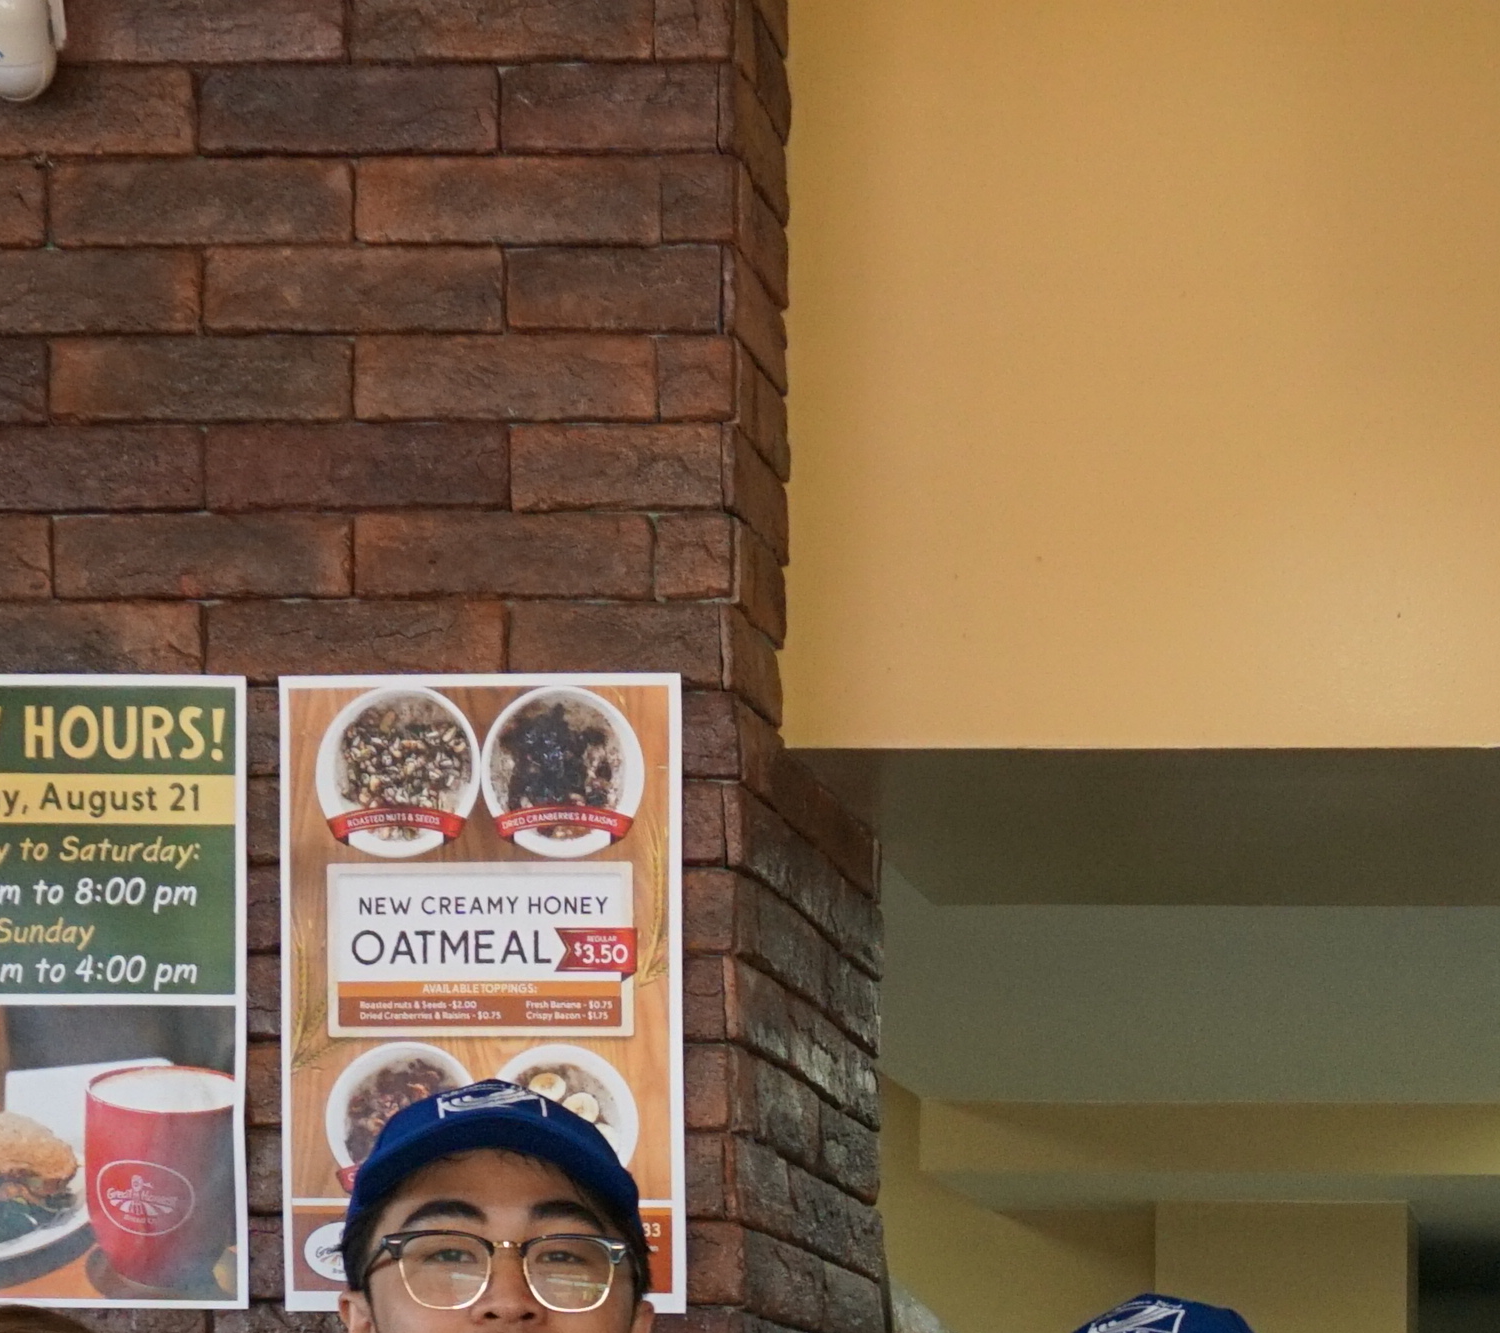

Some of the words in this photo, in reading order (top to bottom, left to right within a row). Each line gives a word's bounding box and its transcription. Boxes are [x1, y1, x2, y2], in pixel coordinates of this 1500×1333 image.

[24, 704, 226, 762] HOURS!
[39, 781, 158, 818] August
[168, 782, 201, 812] 21
[347, 813, 385, 827] ROASTED
[385, 811, 407, 824] NUTS
[415, 813, 441, 827] SEEDS
[524, 811, 581, 825] CRANBERRIES
[20, 837, 50, 862] to
[59, 835, 201, 870] Saturday:
[34, 877, 65, 906] to
[75, 875, 146, 906] 8:00
[151, 881, 198, 914] pm
[358, 896, 412, 916] NEW
[420, 895, 519, 916] CREAMY
[528, 895, 609, 916] HONEY
[351, 929, 552, 967] OATMEAL
[573, 941, 629, 965] $3.50
[35, 956, 66, 984] to
[75, 954, 147, 984] 4:00
[152, 960, 198, 992] pm
